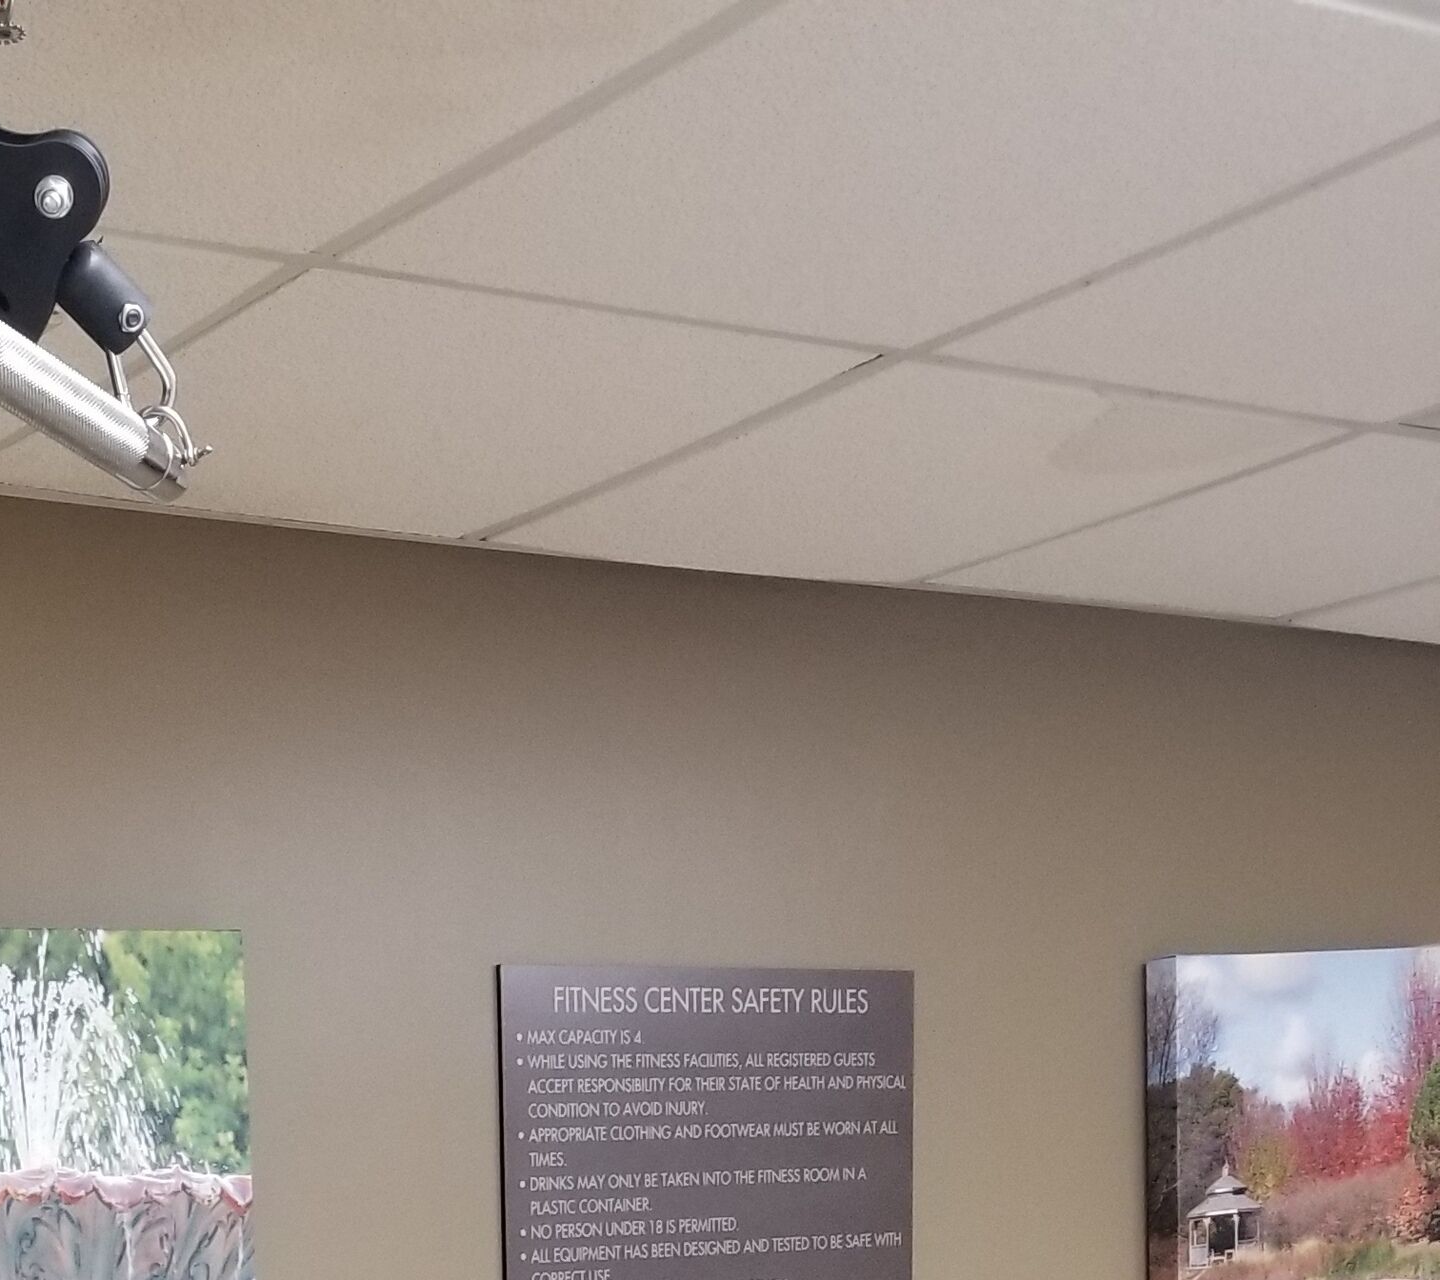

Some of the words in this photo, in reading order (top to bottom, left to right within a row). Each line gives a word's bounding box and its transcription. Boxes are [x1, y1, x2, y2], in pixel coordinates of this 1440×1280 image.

[554, 987, 638, 1013] FITNESS
[644, 987, 725, 1013] CENTER
[732, 988, 804, 1013] SAFETY
[811, 989, 868, 1014] RULES
[528, 1031, 555, 1044] MAX
[559, 1029, 617, 1045] CAPACITY
[621, 1030, 631, 1044] IS
[528, 1054, 565, 1069] WHILE
[568, 1055, 608, 1069] USING
[611, 1054, 635, 1068] THE
[636, 1054, 680, 1068] FITNESS
[684, 1054, 742, 1070] FACILITIES,
[745, 1053, 764, 1067] ALL
[767, 1052, 831, 1067] REGISTERED
[833, 1052, 876, 1067] GUESTS
[528, 1078, 574, 1094] ACCEPT
[577, 1077, 665, 1093] RESPONSIBILITY
[669, 1077, 692, 1092] FOR
[696, 1078, 725, 1091] THEIR
[728, 1076, 762, 1091] STATE
[764, 1076, 781, 1091] OF
[784, 1076, 825, 1090] HEALTH
[828, 1076, 853, 1089] AND
[856, 1075, 906, 1089] PHYSICAL
[528, 1103, 600, 1118] CONDITION
[603, 1102, 620, 1117] TO
[623, 1101, 662, 1116] AVOID
[665, 1100, 708, 1116] INJURY.
[528, 1126, 607, 1143] APPROPRIATE
[610, 1125, 672, 1141] CLOTHING
[674, 1125, 702, 1139] AND
[704, 1123, 771, 1138] FOOTWEAR
[773, 1122, 804, 1137] MUST
[807, 1122, 820, 1136] BE
[822, 1121, 860, 1135] WORN
[863, 1121, 877, 1134] AT
[879, 1120, 899, 1134] ALL
[529, 1152, 567, 1167] TIMES.
[530, 1176, 574, 1191] DRINKS
[577, 1175, 606, 1190] MAY
[608, 1173, 642, 1189] ONLY
[645, 1173, 658, 1187] BE
[660, 1172, 700, 1187] TAKEN
[702, 1171, 731, 1186] INTO
[733, 1170, 755, 1184] THE
[758, 1169, 800, 1183] FITNESS
[803, 1168, 840, 1182] ROOM
[843, 1168, 855, 1181] IN
[857, 1167, 867, 1180] A
[530, 1199, 576, 1215] PLASTIC
[579, 1197, 652, 1213] CONTAINER.
[531, 1225, 552, 1240] NO
[555, 1223, 602, 1239] PERSON
[605, 1220, 645, 1236] UNDER
[649, 1220, 663, 1234] 18
[666, 1220, 676, 1234] IS
[679, 1217, 739, 1232] PERMITTED.
[531, 1249, 551, 1264] ALL
[554, 1245, 621, 1263] EQUIPMENT
[624, 1244, 648, 1260] HAS
[651, 1242, 680, 1259] BEEN
[683, 1241, 741, 1256] DESIGNED
[743, 1239, 769, 1253] AND
[772, 1236, 810, 1252] TESTED
[812, 1235, 828, 1250] TO
[831, 1235, 843, 1249] BE
[845, 1233, 872, 1248] SAFE
[874, 1232, 902, 1247] WITH
